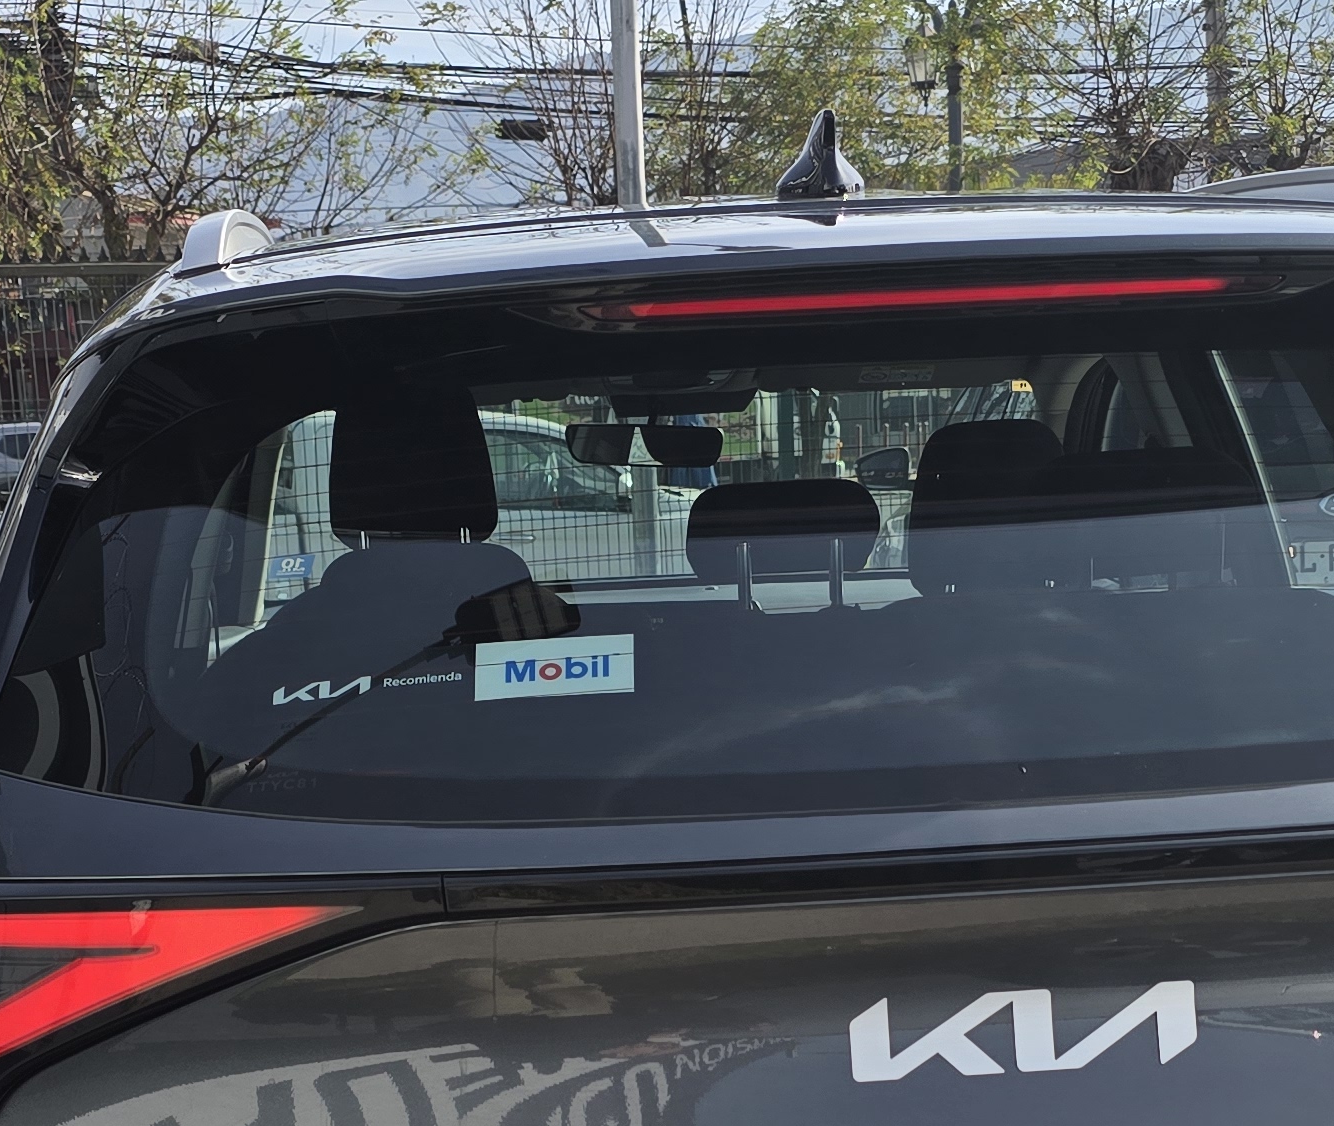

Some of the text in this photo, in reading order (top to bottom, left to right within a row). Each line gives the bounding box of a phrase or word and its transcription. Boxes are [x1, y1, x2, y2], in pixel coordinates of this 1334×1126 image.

[505, 655, 610, 683] Mobil
[272, 672, 462, 705] KIA Recomienda
[849, 980, 1198, 1083] KIA
